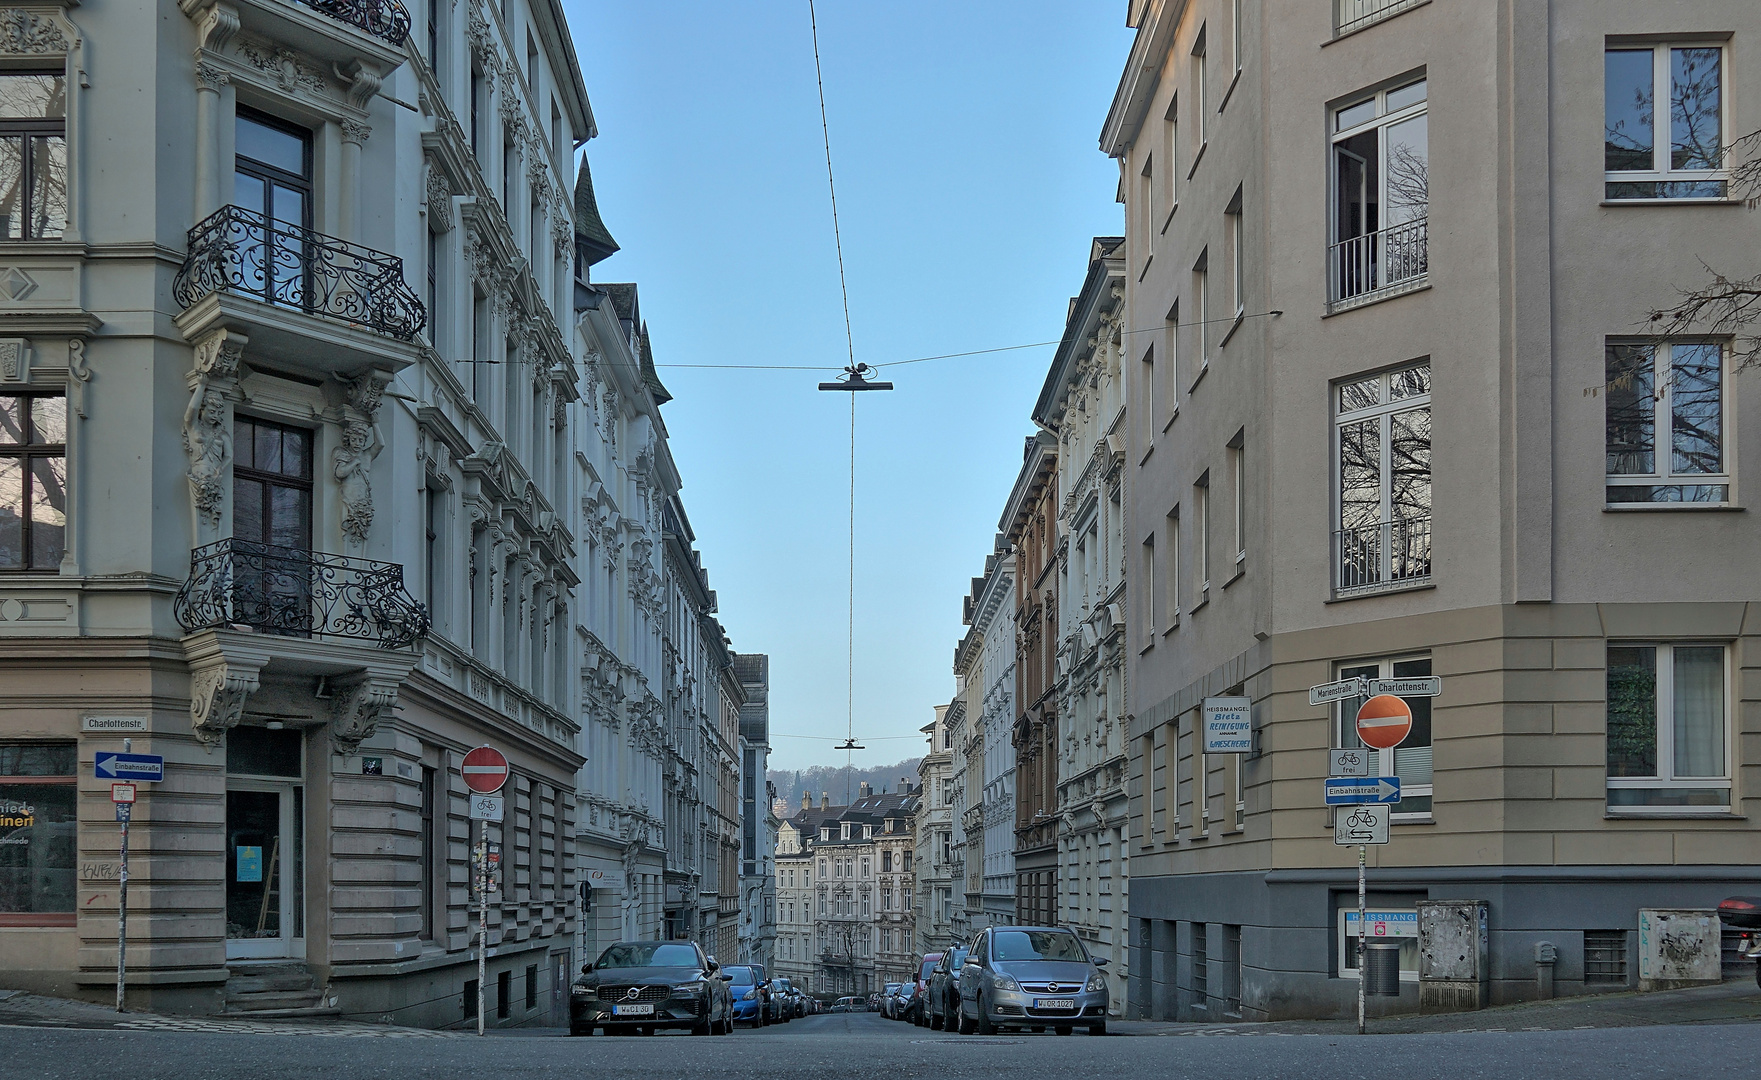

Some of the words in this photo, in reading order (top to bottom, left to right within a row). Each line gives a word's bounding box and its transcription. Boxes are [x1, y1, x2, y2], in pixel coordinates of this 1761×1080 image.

[1317, 683, 1352, 698] Marienstraße
[1378, 682, 1430, 692] Charlottenstr.
[1210, 722, 1250, 730] REINIGUNG
[114, 762, 160, 771] Einbahnstraße
[1342, 766, 1356, 774] frei
[1329, 786, 1380, 795] Einbahnstraße
